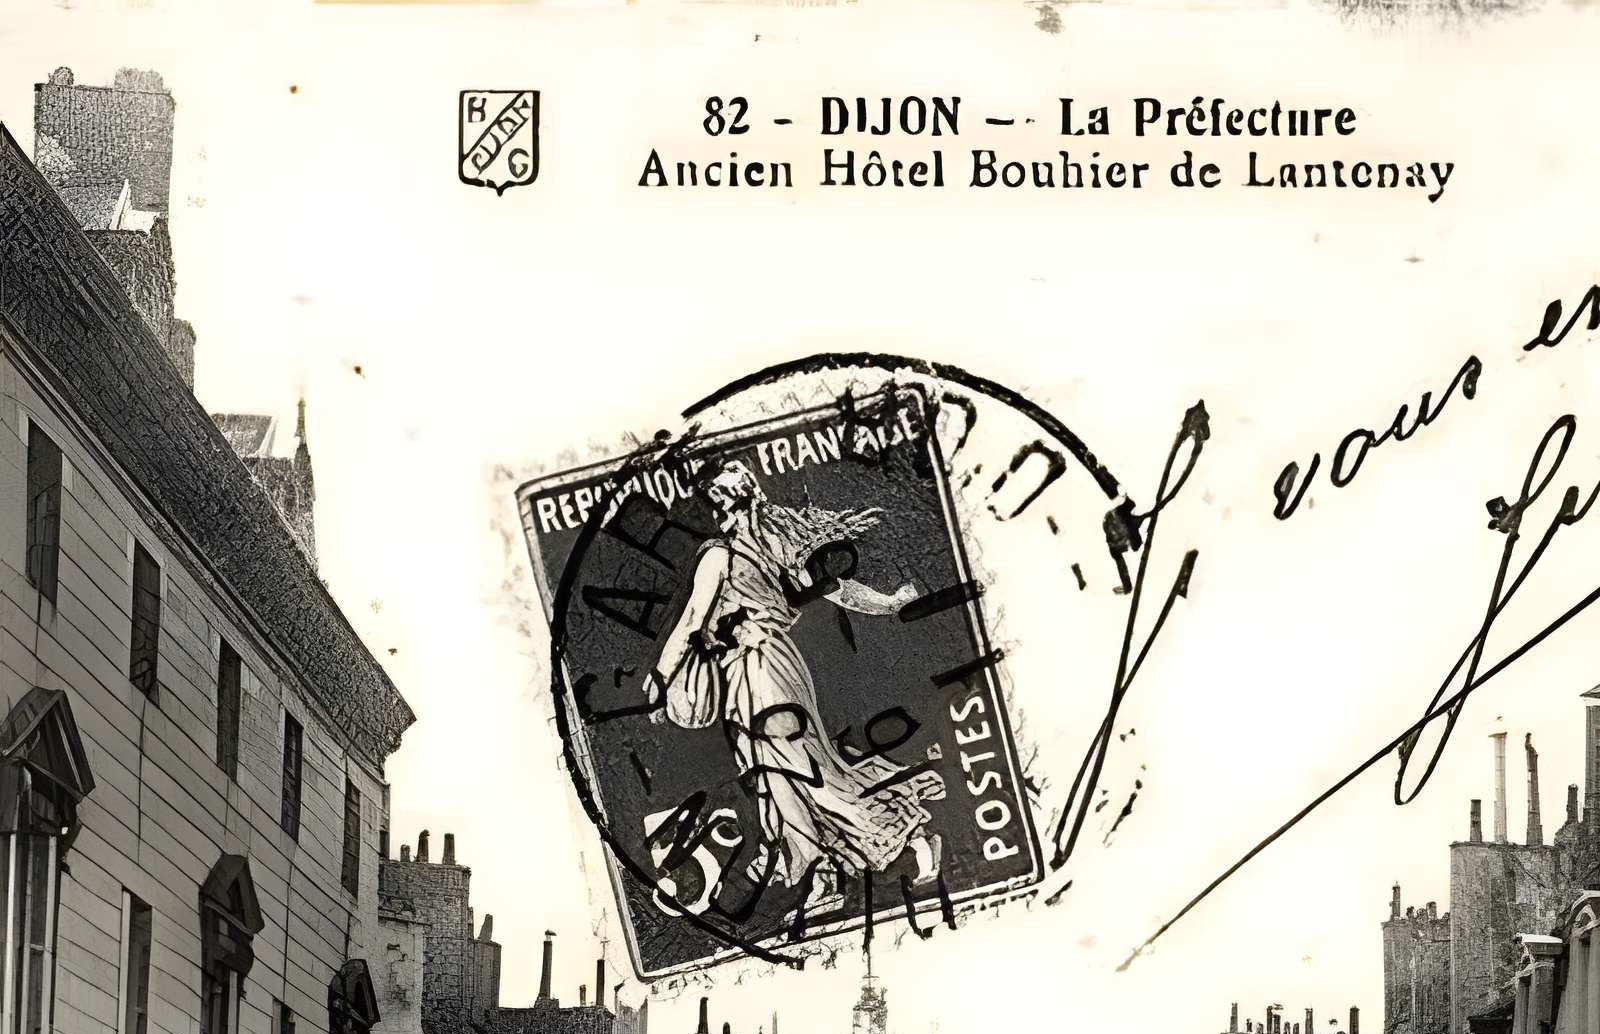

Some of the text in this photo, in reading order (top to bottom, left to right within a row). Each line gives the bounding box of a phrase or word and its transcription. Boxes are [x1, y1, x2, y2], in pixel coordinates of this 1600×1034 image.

[535, 406, 924, 535] REPIQU FRANAIE
[1273, 354, 1484, 521] vous
[948, 692, 1021, 863] POSTES
